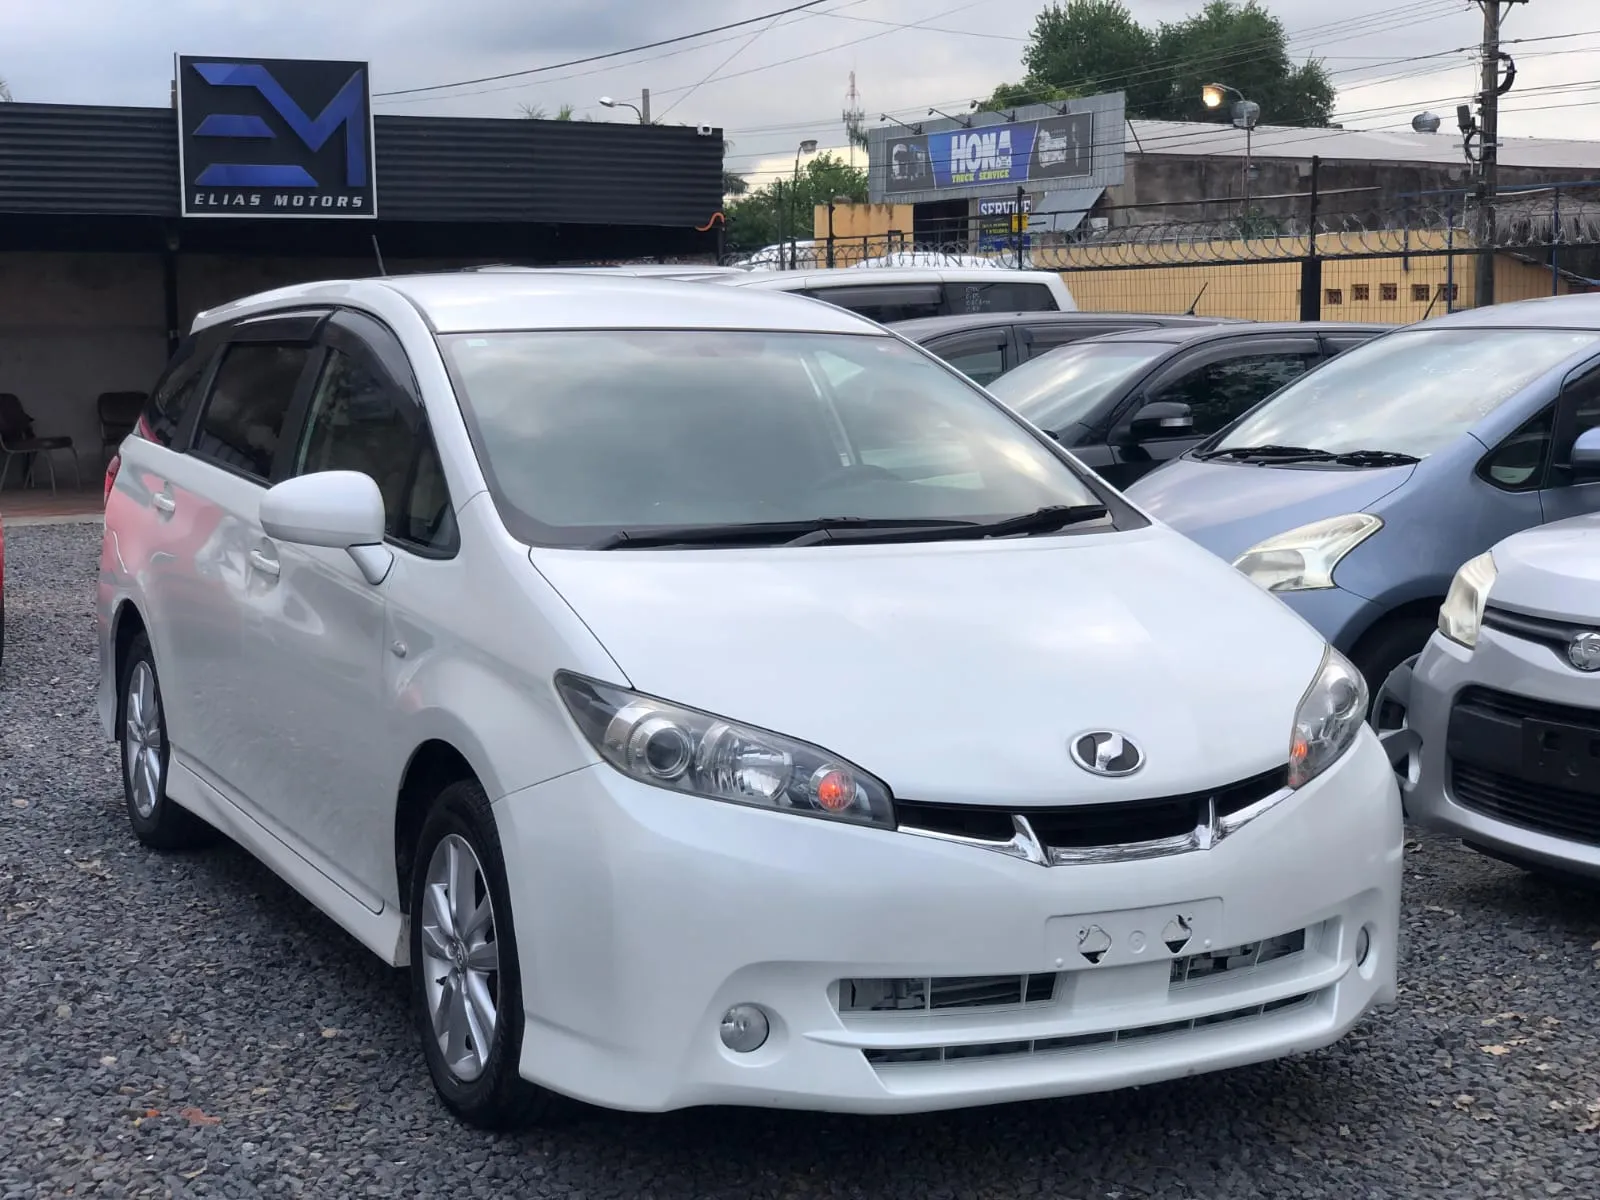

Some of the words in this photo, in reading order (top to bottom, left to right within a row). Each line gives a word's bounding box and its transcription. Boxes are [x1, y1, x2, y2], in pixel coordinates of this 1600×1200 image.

[191, 62, 367, 188] EM
[952, 172, 975, 184] TRUCK
[979, 169, 1010, 180] SERVICE
[194, 193, 261, 206] ELIAS
[274, 195, 363, 208] MOTORS
